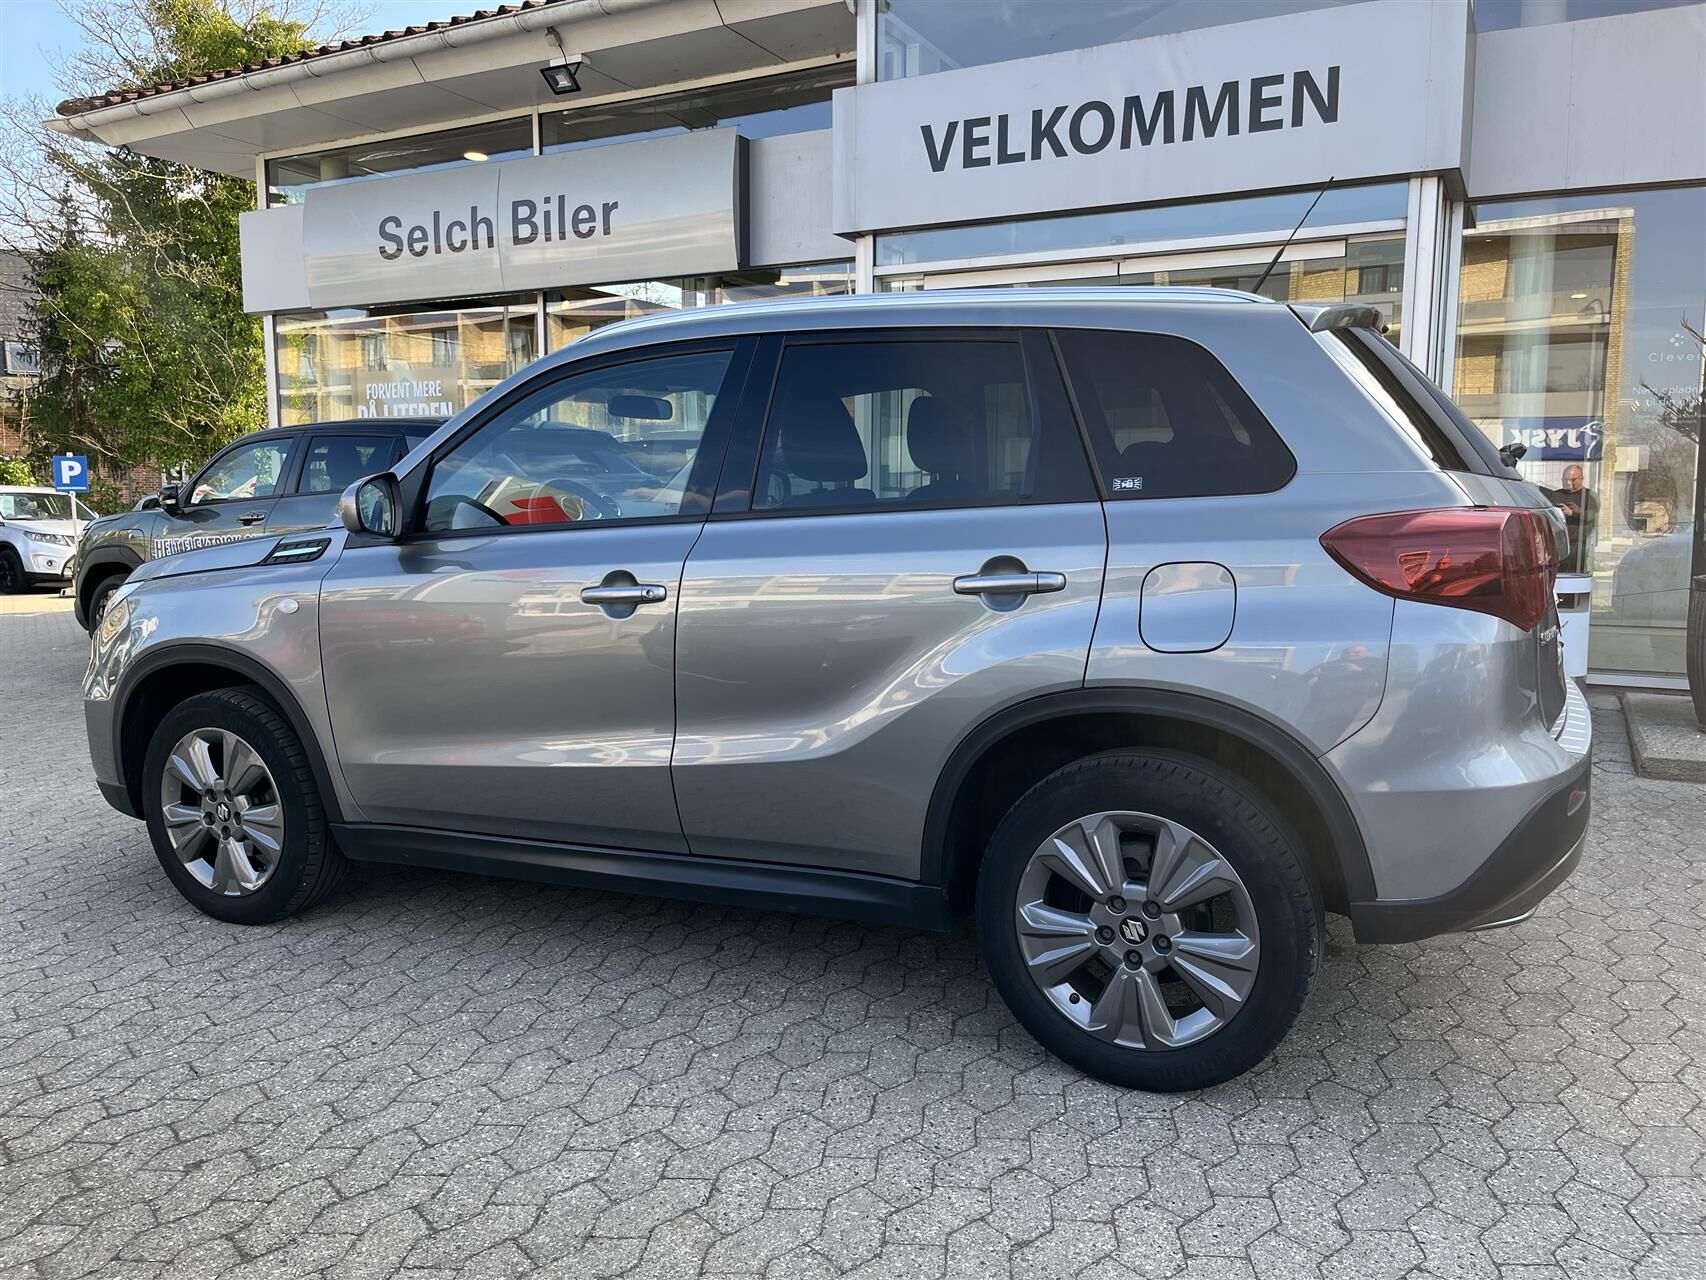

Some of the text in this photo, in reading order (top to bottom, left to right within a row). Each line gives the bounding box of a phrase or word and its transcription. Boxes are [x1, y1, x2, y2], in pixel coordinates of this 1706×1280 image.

[920, 65, 1341, 173] VELKOMMEN
[378, 194, 619, 260] Selch Biler
[366, 380, 442, 400] FORVENT MERE
[60, 460, 82, 484] P
